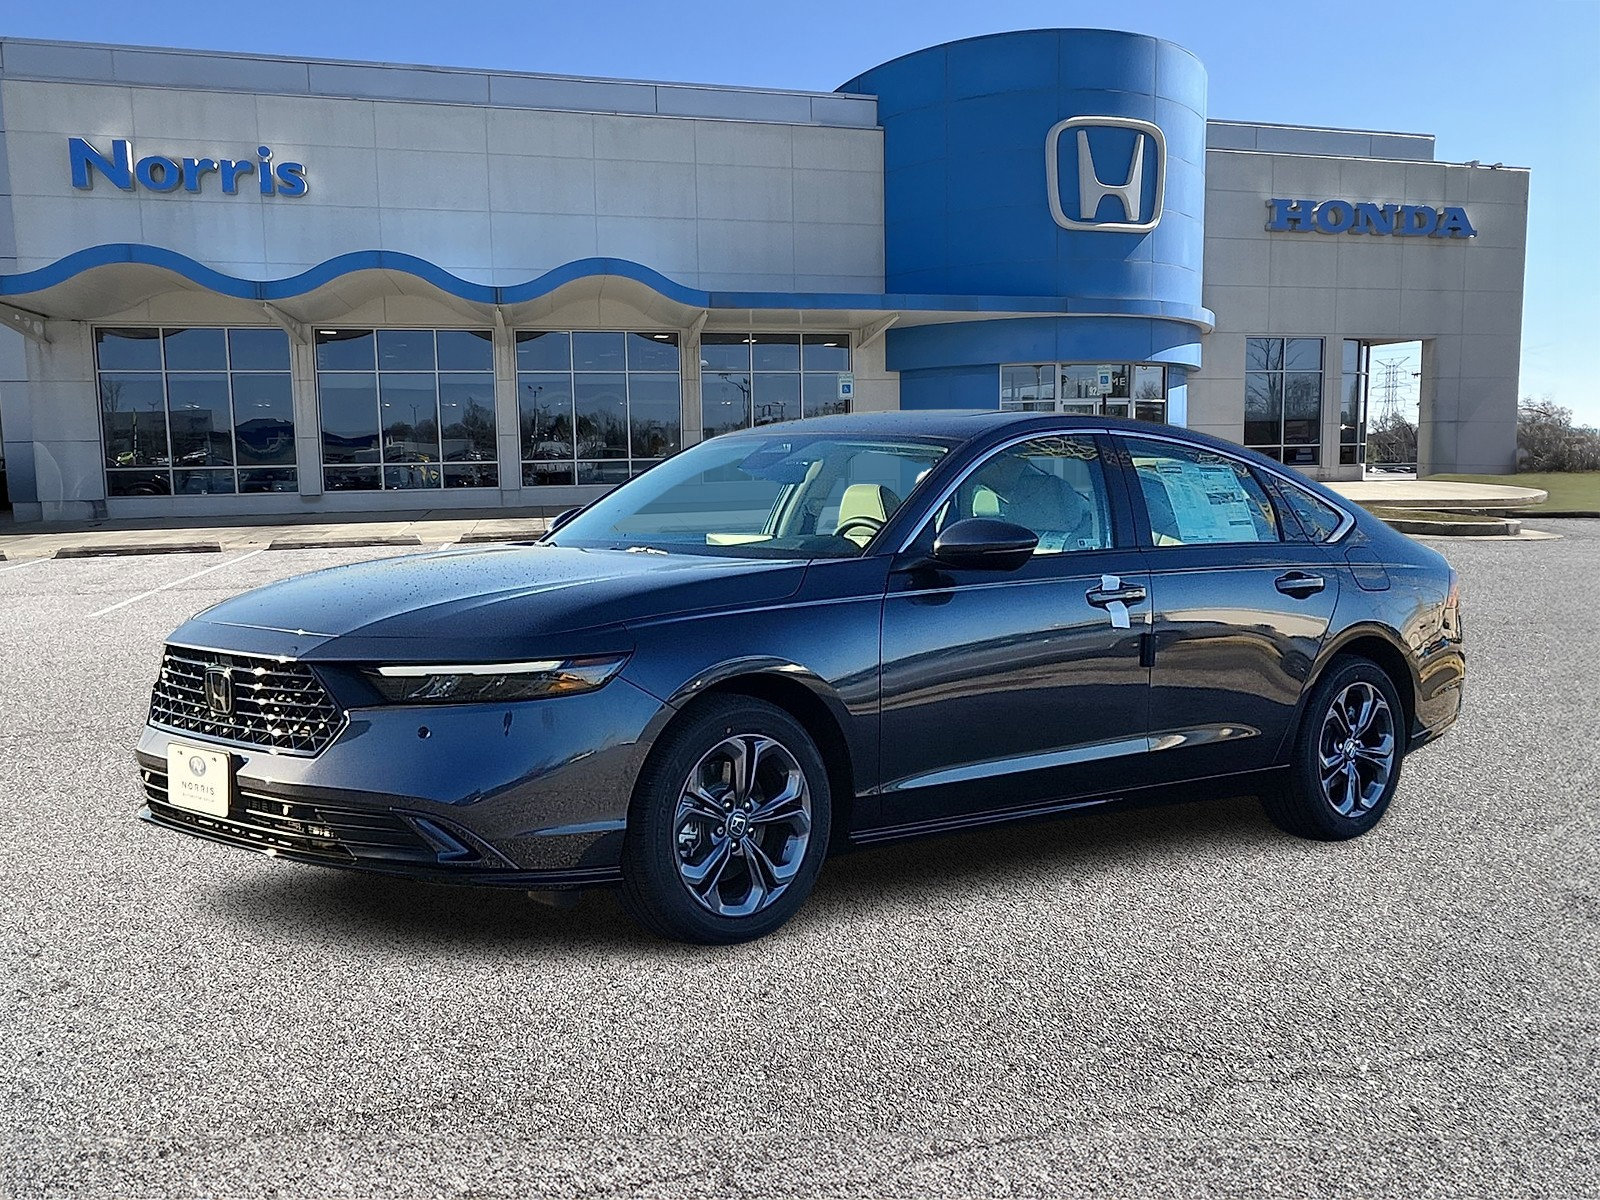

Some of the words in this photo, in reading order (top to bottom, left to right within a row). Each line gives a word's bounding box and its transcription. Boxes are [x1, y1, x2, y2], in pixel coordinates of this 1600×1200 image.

[68, 137, 308, 197] Norris
[1265, 198, 1478, 239] HONDA
[181, 781, 215, 796] NORRIS
